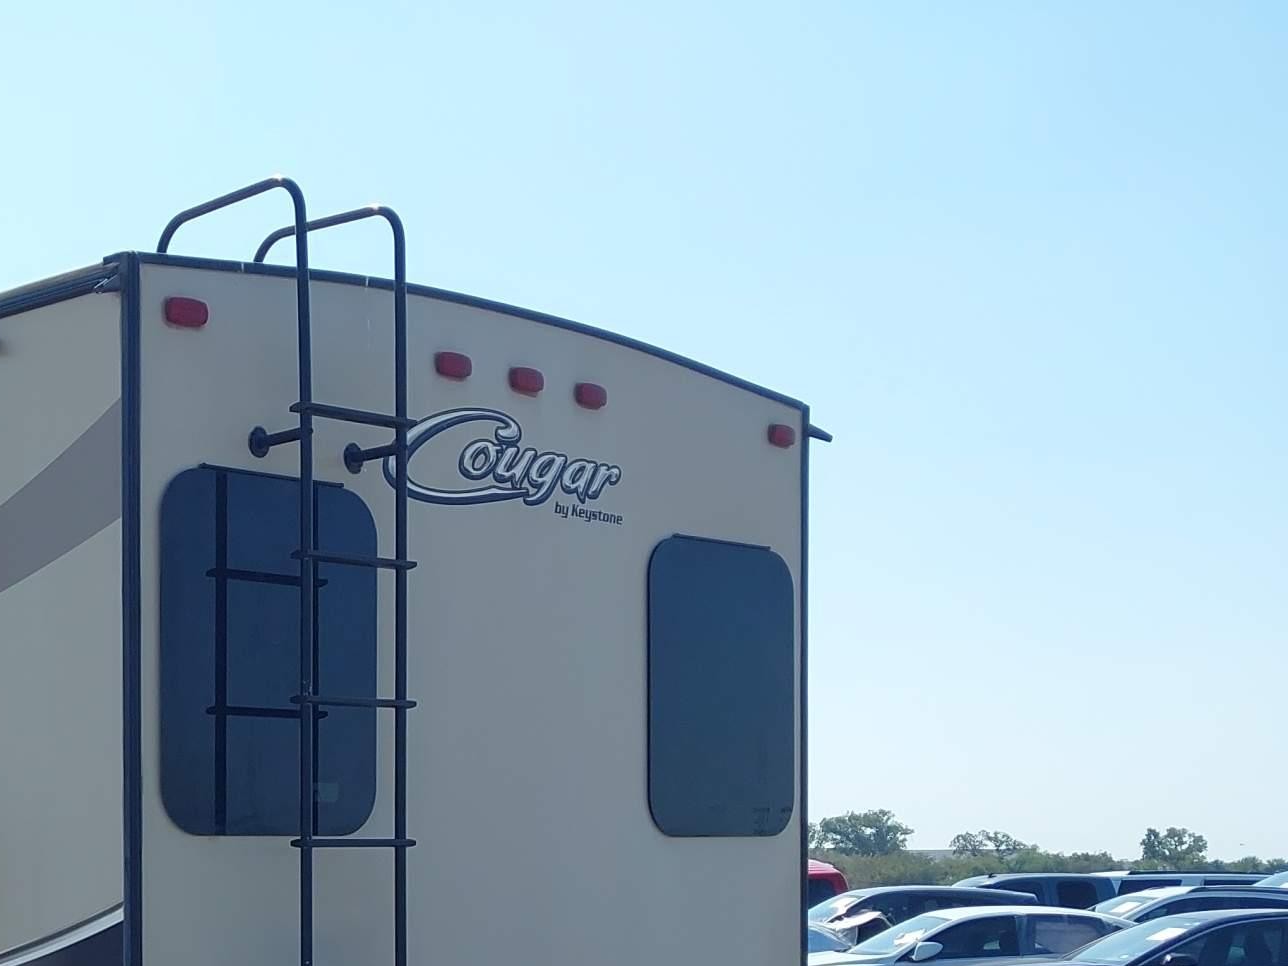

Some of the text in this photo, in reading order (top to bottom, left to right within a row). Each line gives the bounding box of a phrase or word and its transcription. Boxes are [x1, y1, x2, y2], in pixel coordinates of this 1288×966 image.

[383, 407, 622, 506] Cougar
[554, 501, 624, 525] by Keystone
